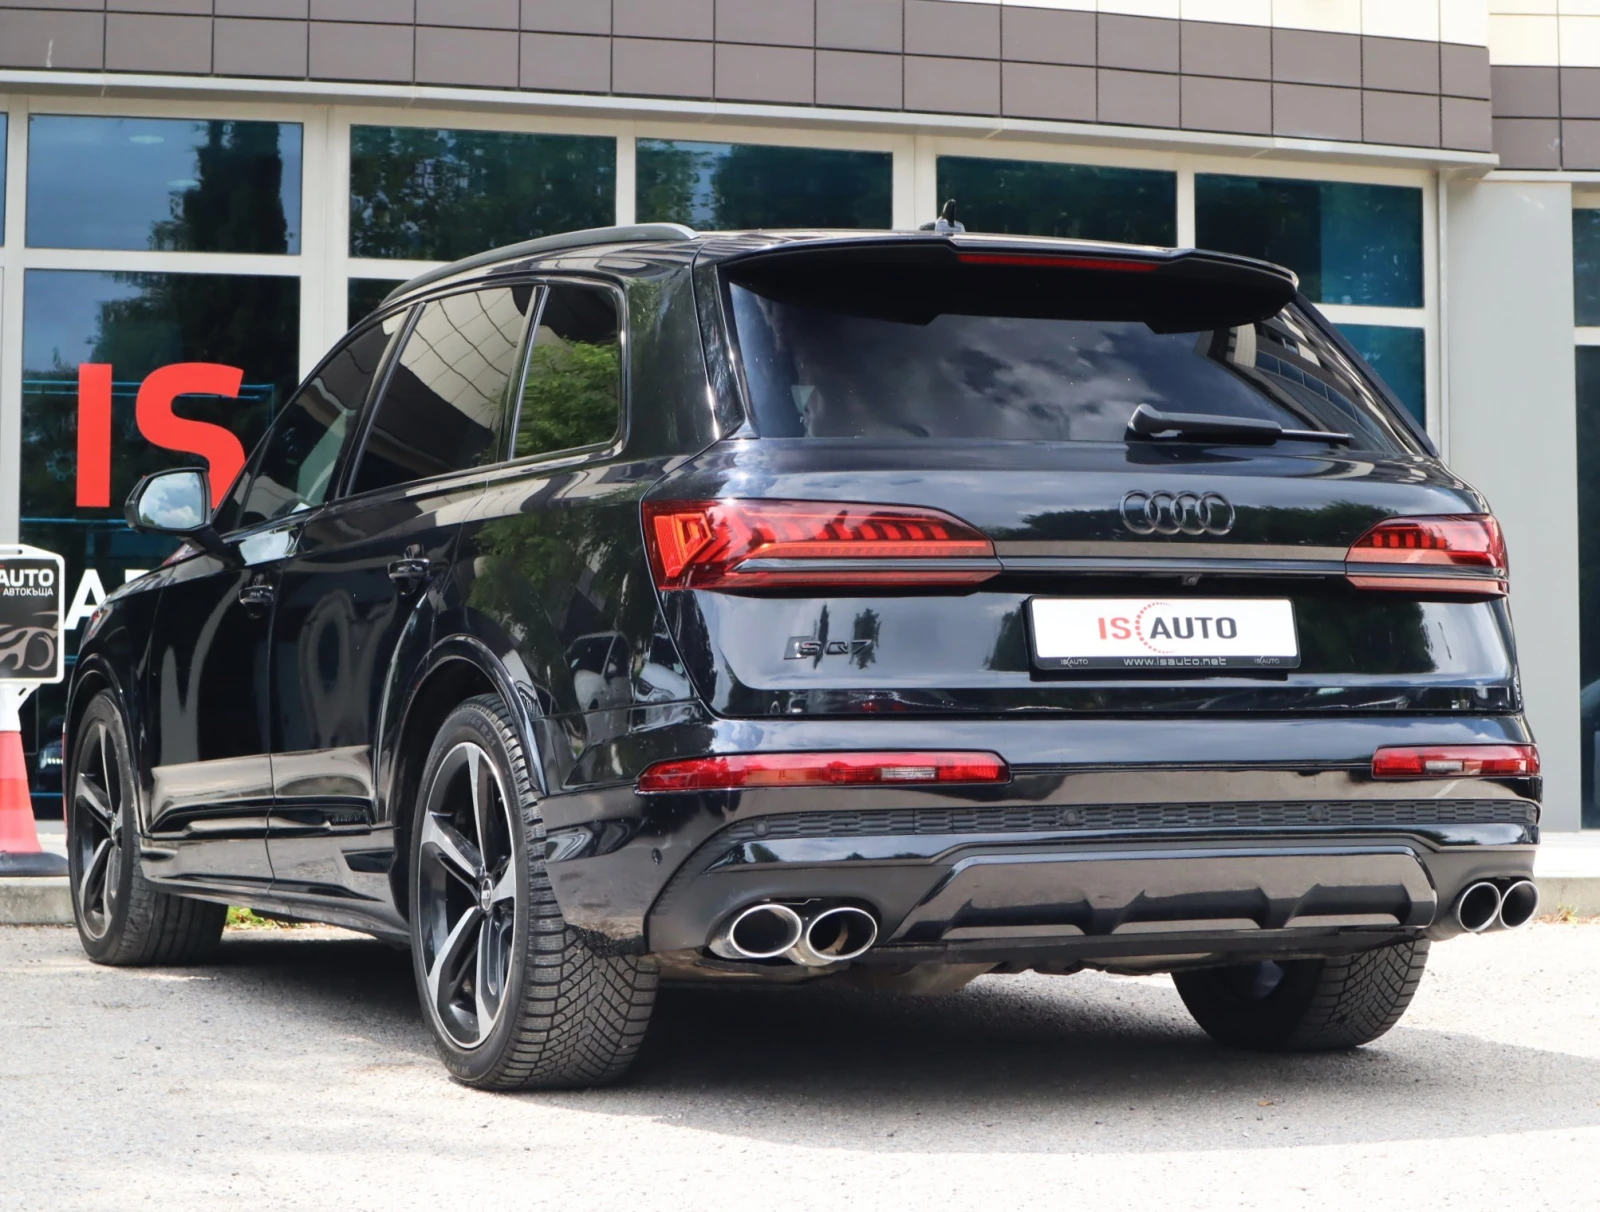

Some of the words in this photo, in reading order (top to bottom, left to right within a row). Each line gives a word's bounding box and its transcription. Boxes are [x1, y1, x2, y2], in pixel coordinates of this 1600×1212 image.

[76, 362, 246, 508] IS
[0, 569, 54, 587] AUTO
[3, 588, 54, 597] АВТОКЪЩА
[1098, 617, 1132, 640] IS
[1150, 617, 1238, 640] AUTO
[799, 640, 872, 656] SQ7
[1123, 657, 1227, 666] www.isauto.net
